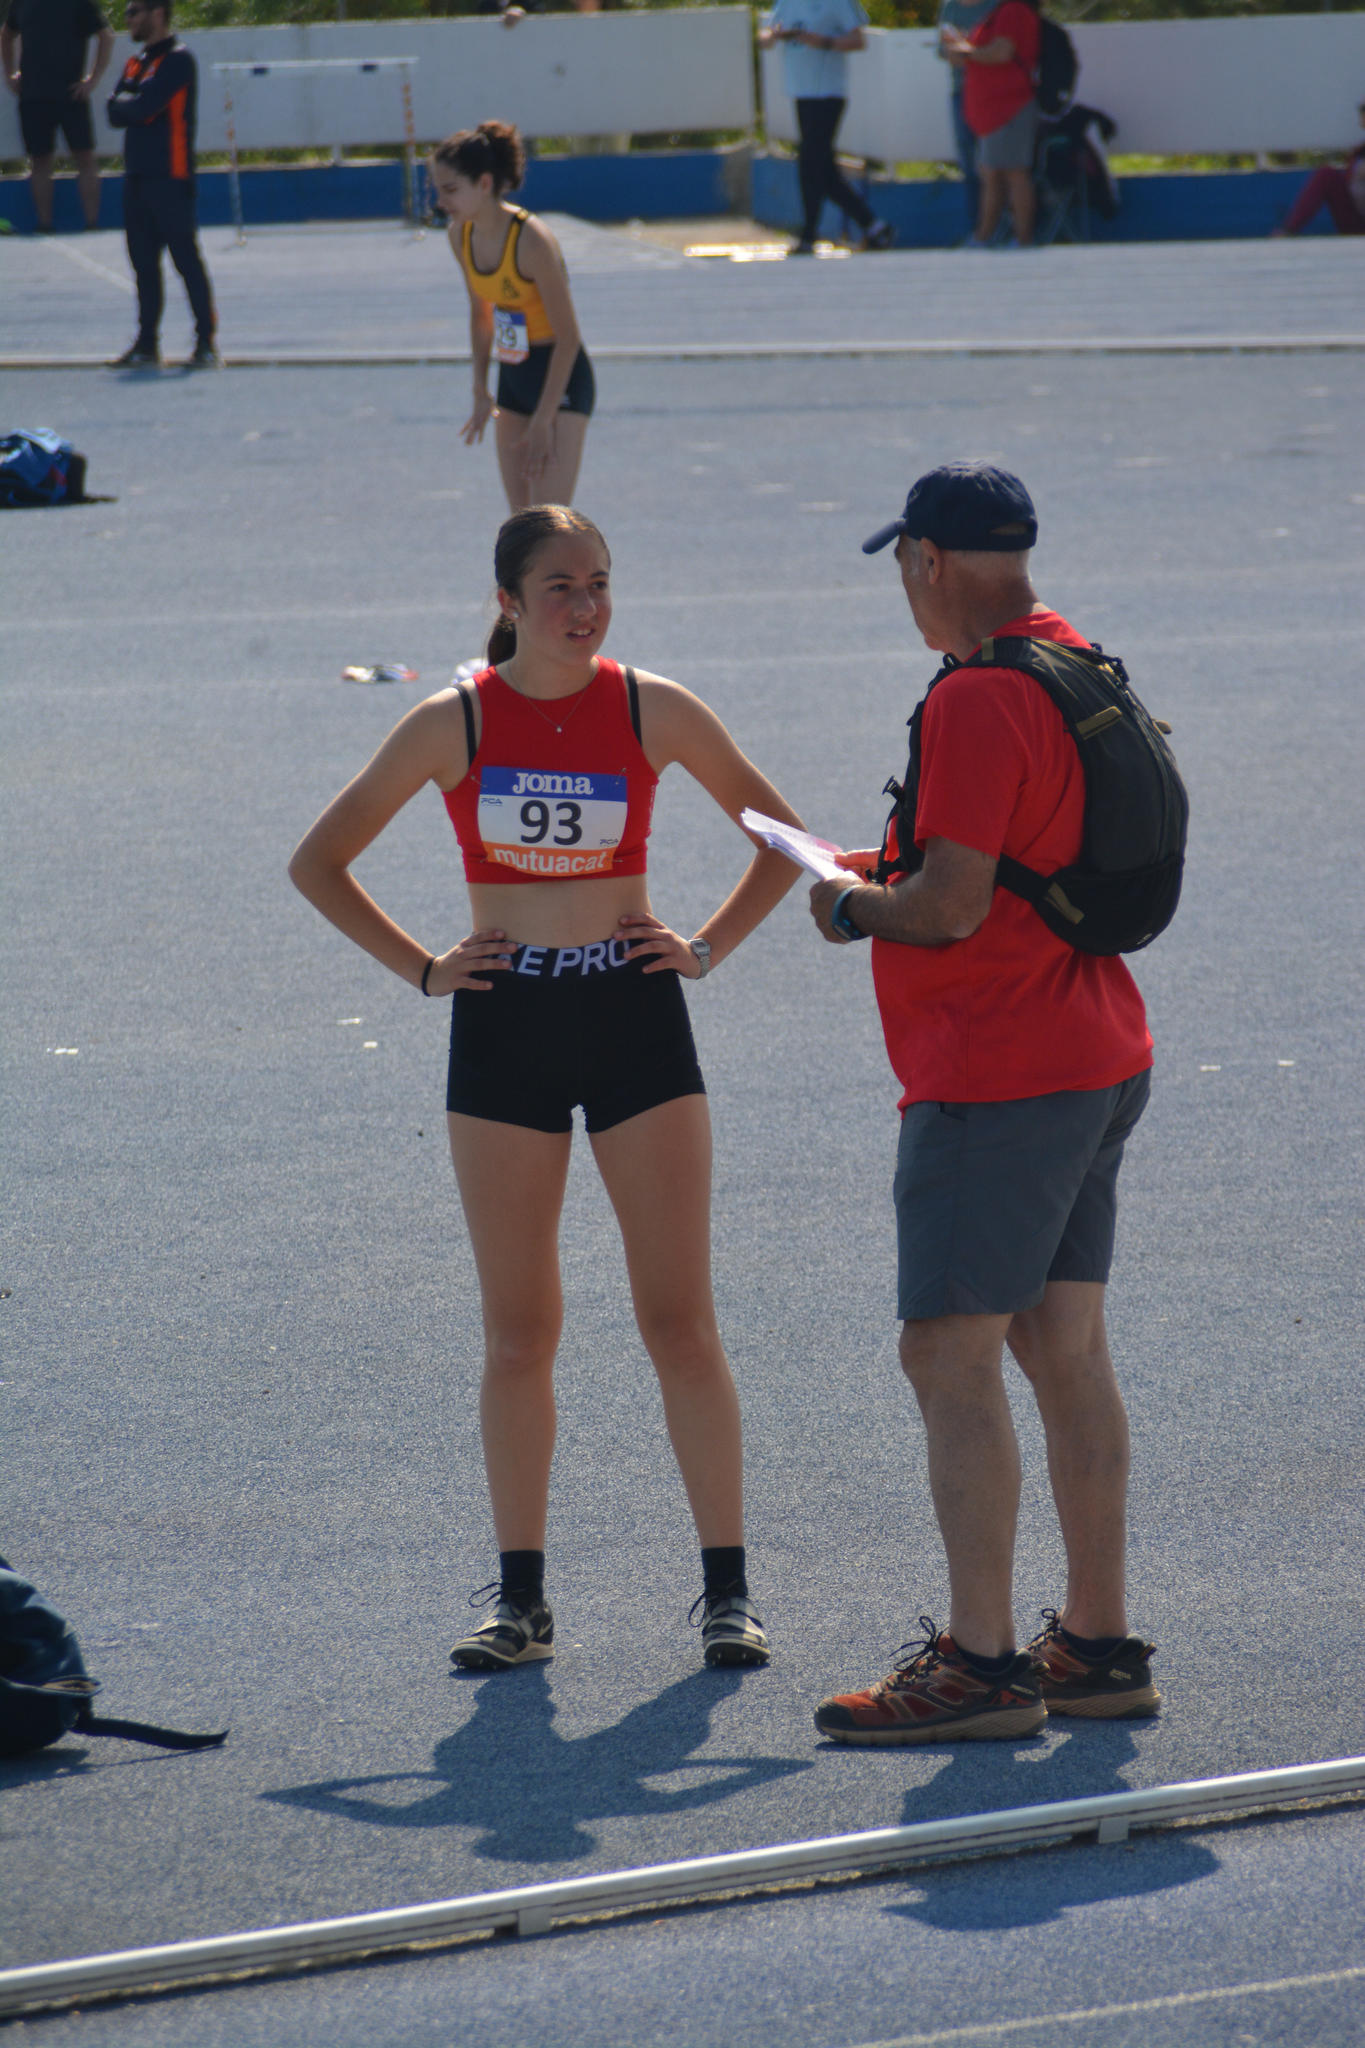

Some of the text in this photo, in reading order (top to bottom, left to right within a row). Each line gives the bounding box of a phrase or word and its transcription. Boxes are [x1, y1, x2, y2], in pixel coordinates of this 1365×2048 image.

[512, 772, 594, 795] Joma
[520, 799, 583, 846] 93
[494, 849, 608, 873] mutuacat
[552, 938, 631, 978] PRO
